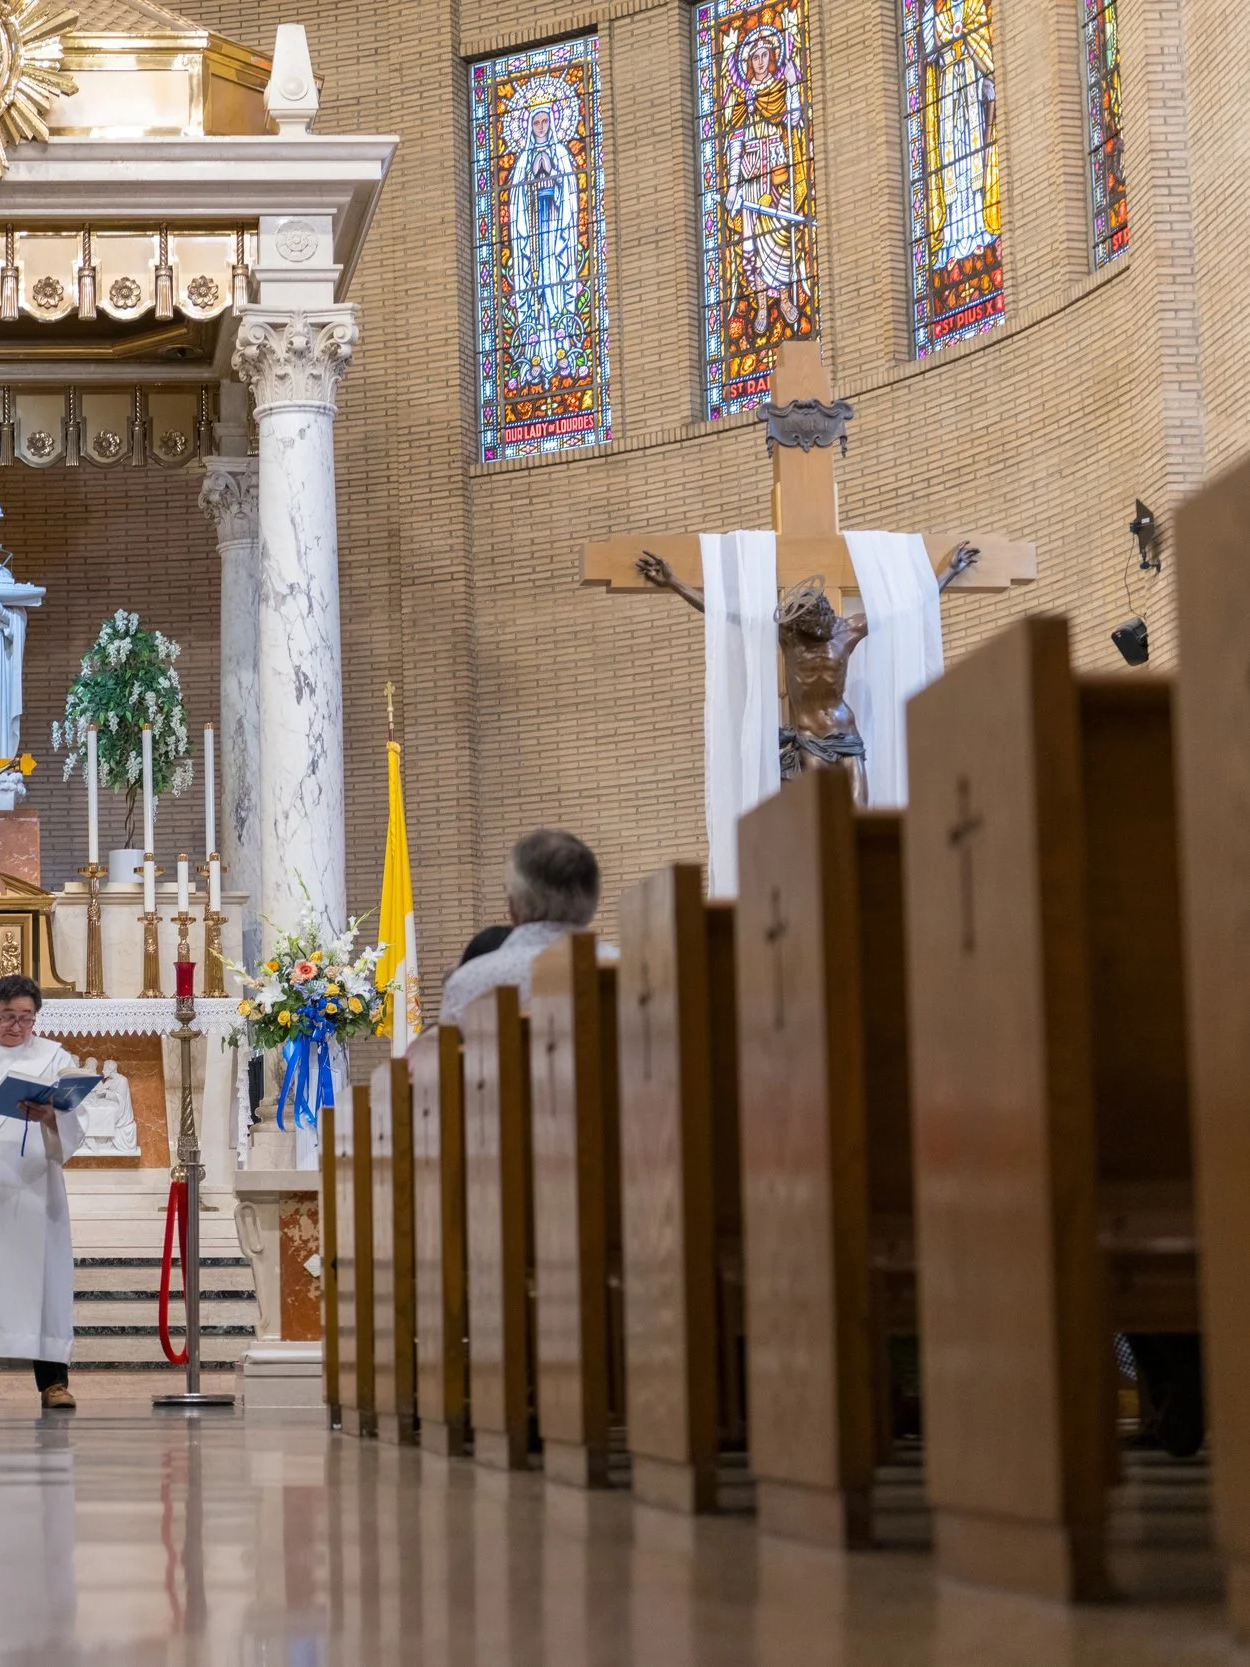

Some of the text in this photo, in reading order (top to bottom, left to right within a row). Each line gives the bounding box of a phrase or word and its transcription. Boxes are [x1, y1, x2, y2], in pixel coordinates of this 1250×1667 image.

[942, 300, 994, 335] ST PIUS X
[730, 382, 743, 398] ST
[506, 427, 525, 442] OUR
[525, 423, 548, 438] LADY
[556, 414, 594, 434] LOURDES
